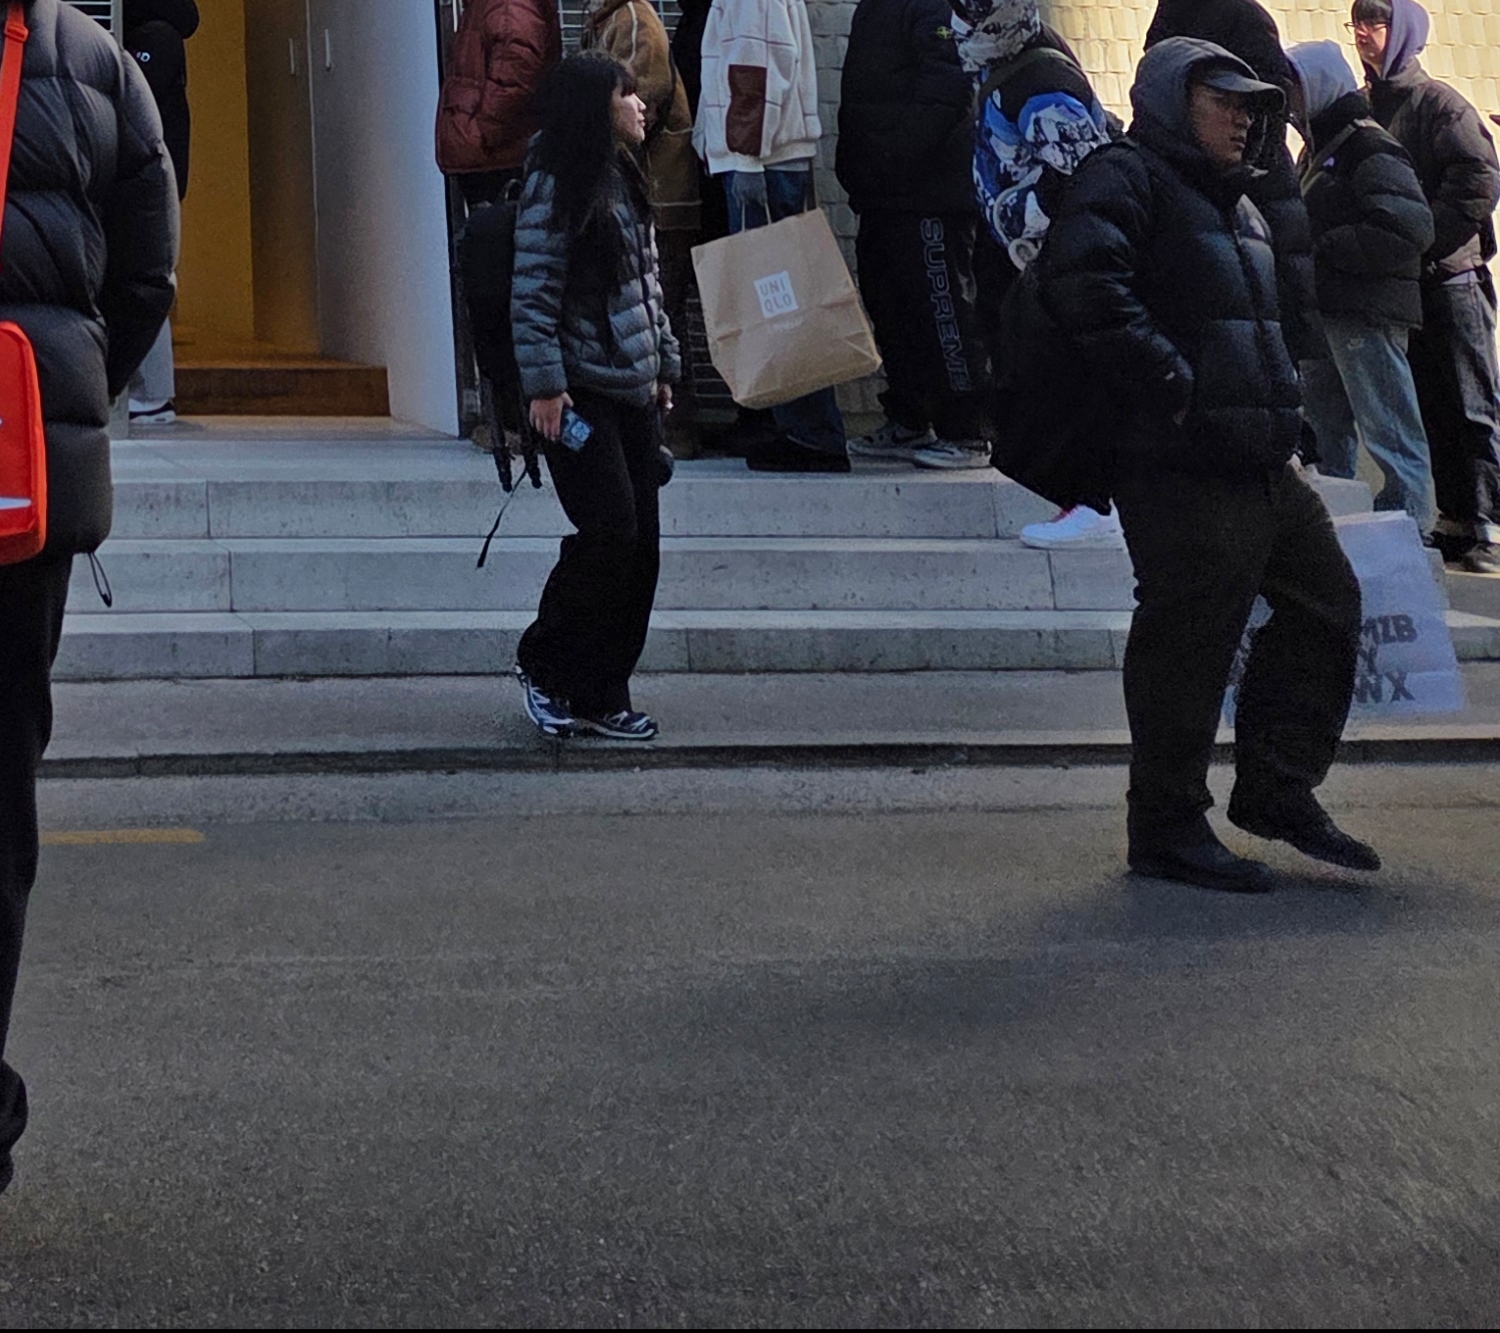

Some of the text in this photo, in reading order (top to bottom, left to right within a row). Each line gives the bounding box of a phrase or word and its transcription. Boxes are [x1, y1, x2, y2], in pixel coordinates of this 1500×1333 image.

[759, 278, 786, 297] UNI
[764, 293, 792, 314] QLO
[920, 217, 972, 392] SUPREME
